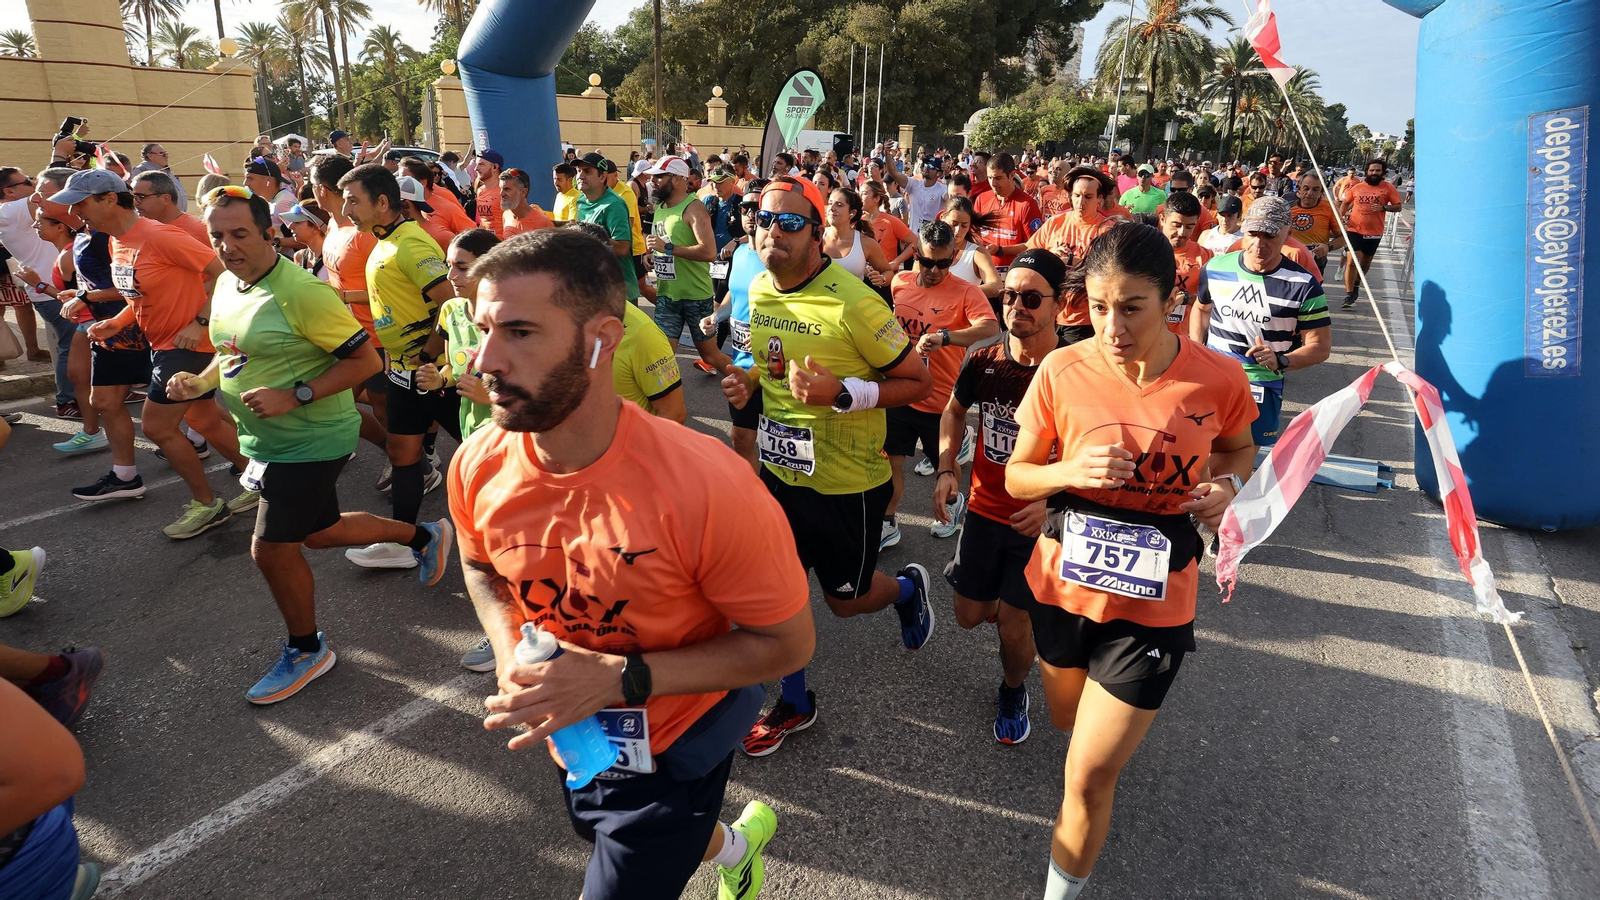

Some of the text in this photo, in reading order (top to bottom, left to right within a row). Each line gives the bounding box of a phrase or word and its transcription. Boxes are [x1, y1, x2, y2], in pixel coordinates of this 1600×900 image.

[786, 106, 811, 114] SPORT
[1534, 116, 1580, 370] deportes@aytojerez.es
[751, 309, 822, 336] Paparunners
[1220, 304, 1271, 325] CIMALP
[873, 318, 895, 341] JUNTOS
[645, 356, 668, 373] JUNTOS
[768, 436, 797, 457] 768
[1091, 527, 1117, 541] XXIX
[1086, 541, 1140, 572] 757
[623, 718, 635, 727] 21
